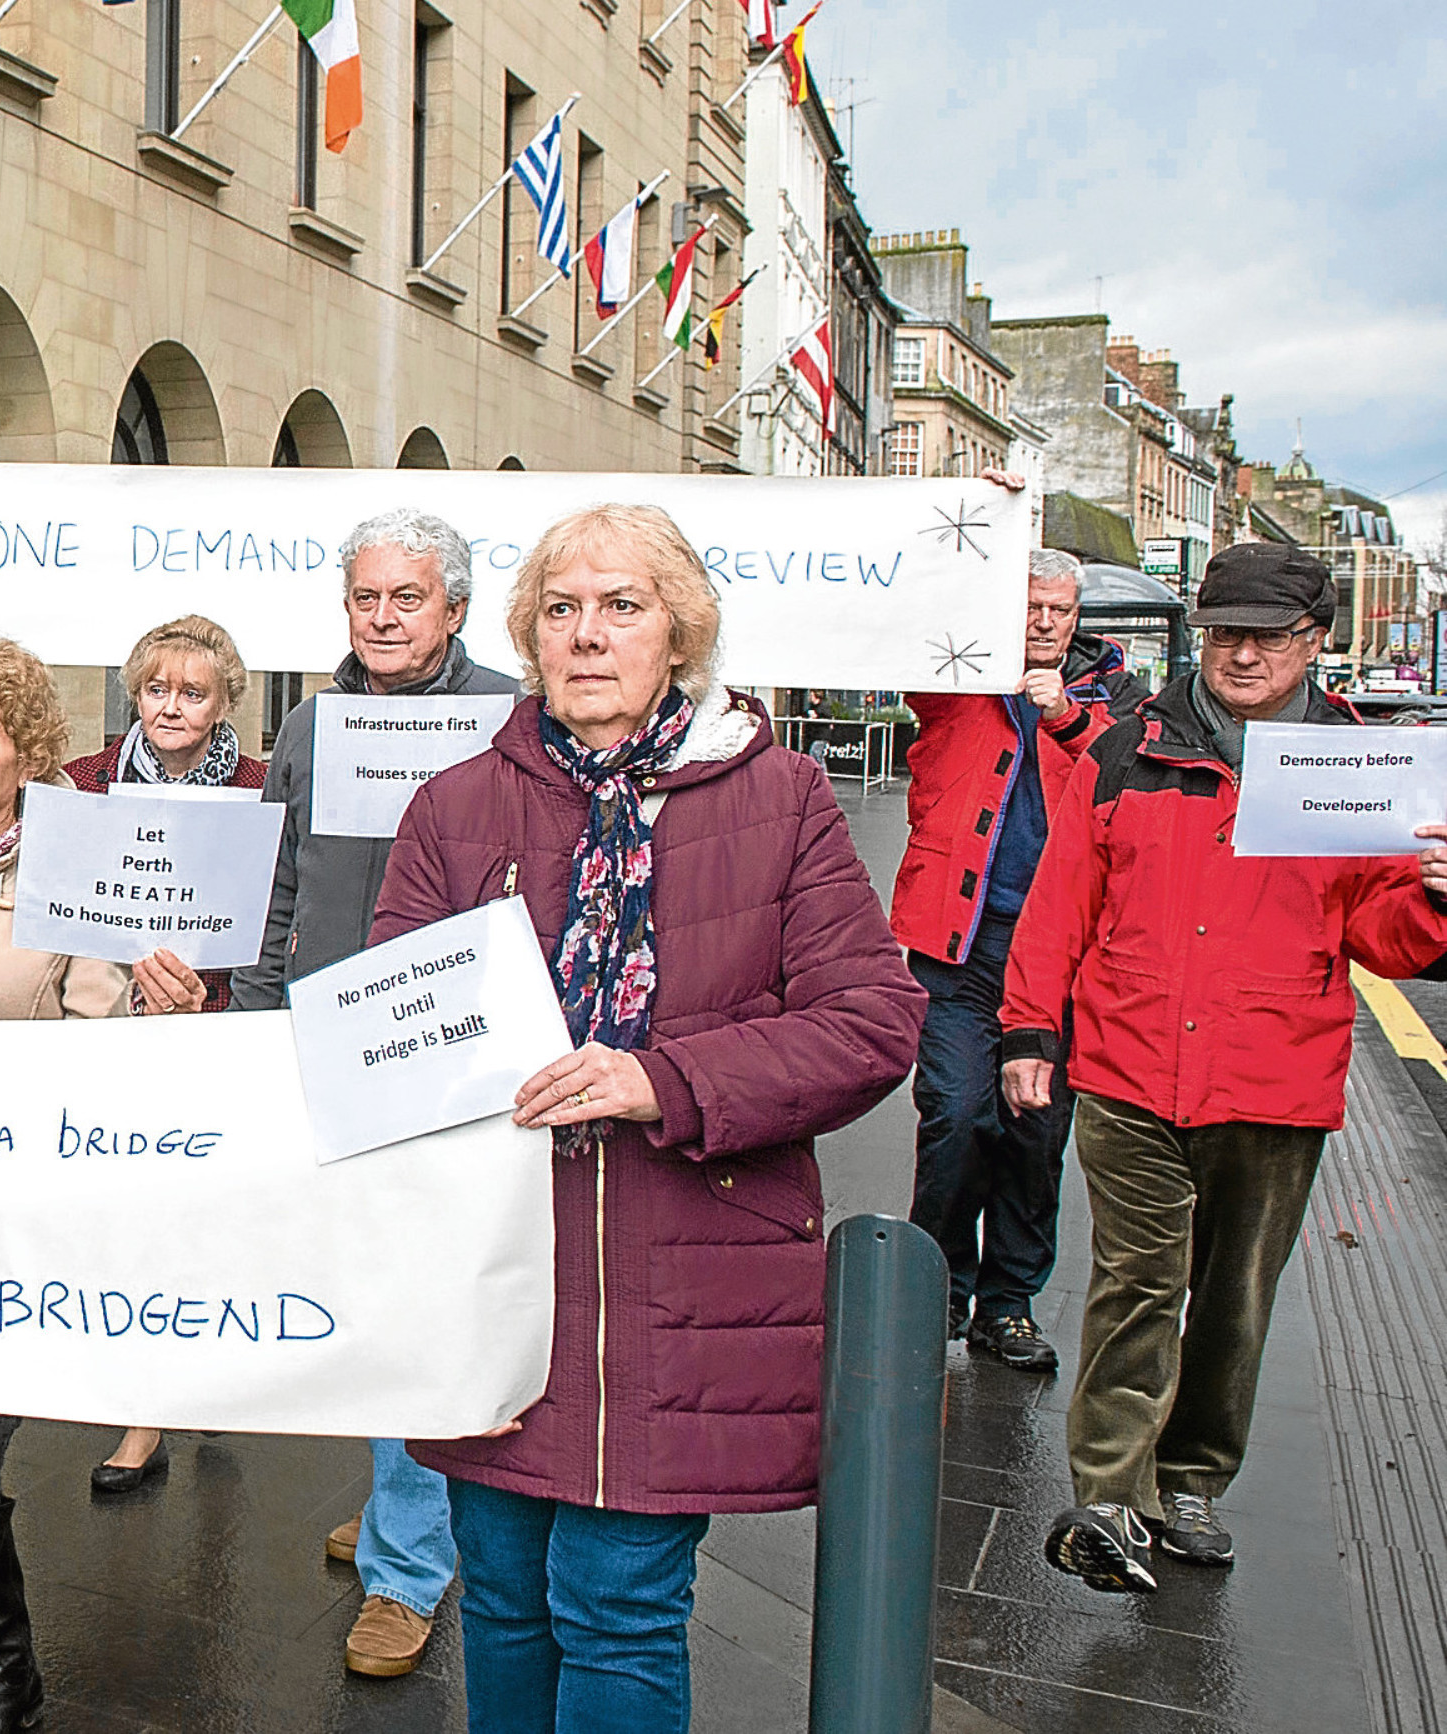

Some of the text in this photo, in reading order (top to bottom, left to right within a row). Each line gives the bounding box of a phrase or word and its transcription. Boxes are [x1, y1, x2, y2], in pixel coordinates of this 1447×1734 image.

[132, 524, 344, 573] DEMAND
[469, 538, 533, 570] FO
[705, 546, 903, 588] REVIEW
[345, 717, 478, 731] Infrastructure first
[1280, 753, 1413, 768] Democracy before
[356, 766, 407, 780] Houses
[1302, 799, 1392, 813] Developers!
[136, 827, 165, 843] Let
[122, 855, 173, 873] Perth
[95, 881, 194, 902] BREATH
[48, 902, 233, 933] No houses till bridge
[337, 948, 476, 1008] No more houses
[392, 992, 436, 1021] Until
[362, 1014, 489, 1066] Bridge is built
